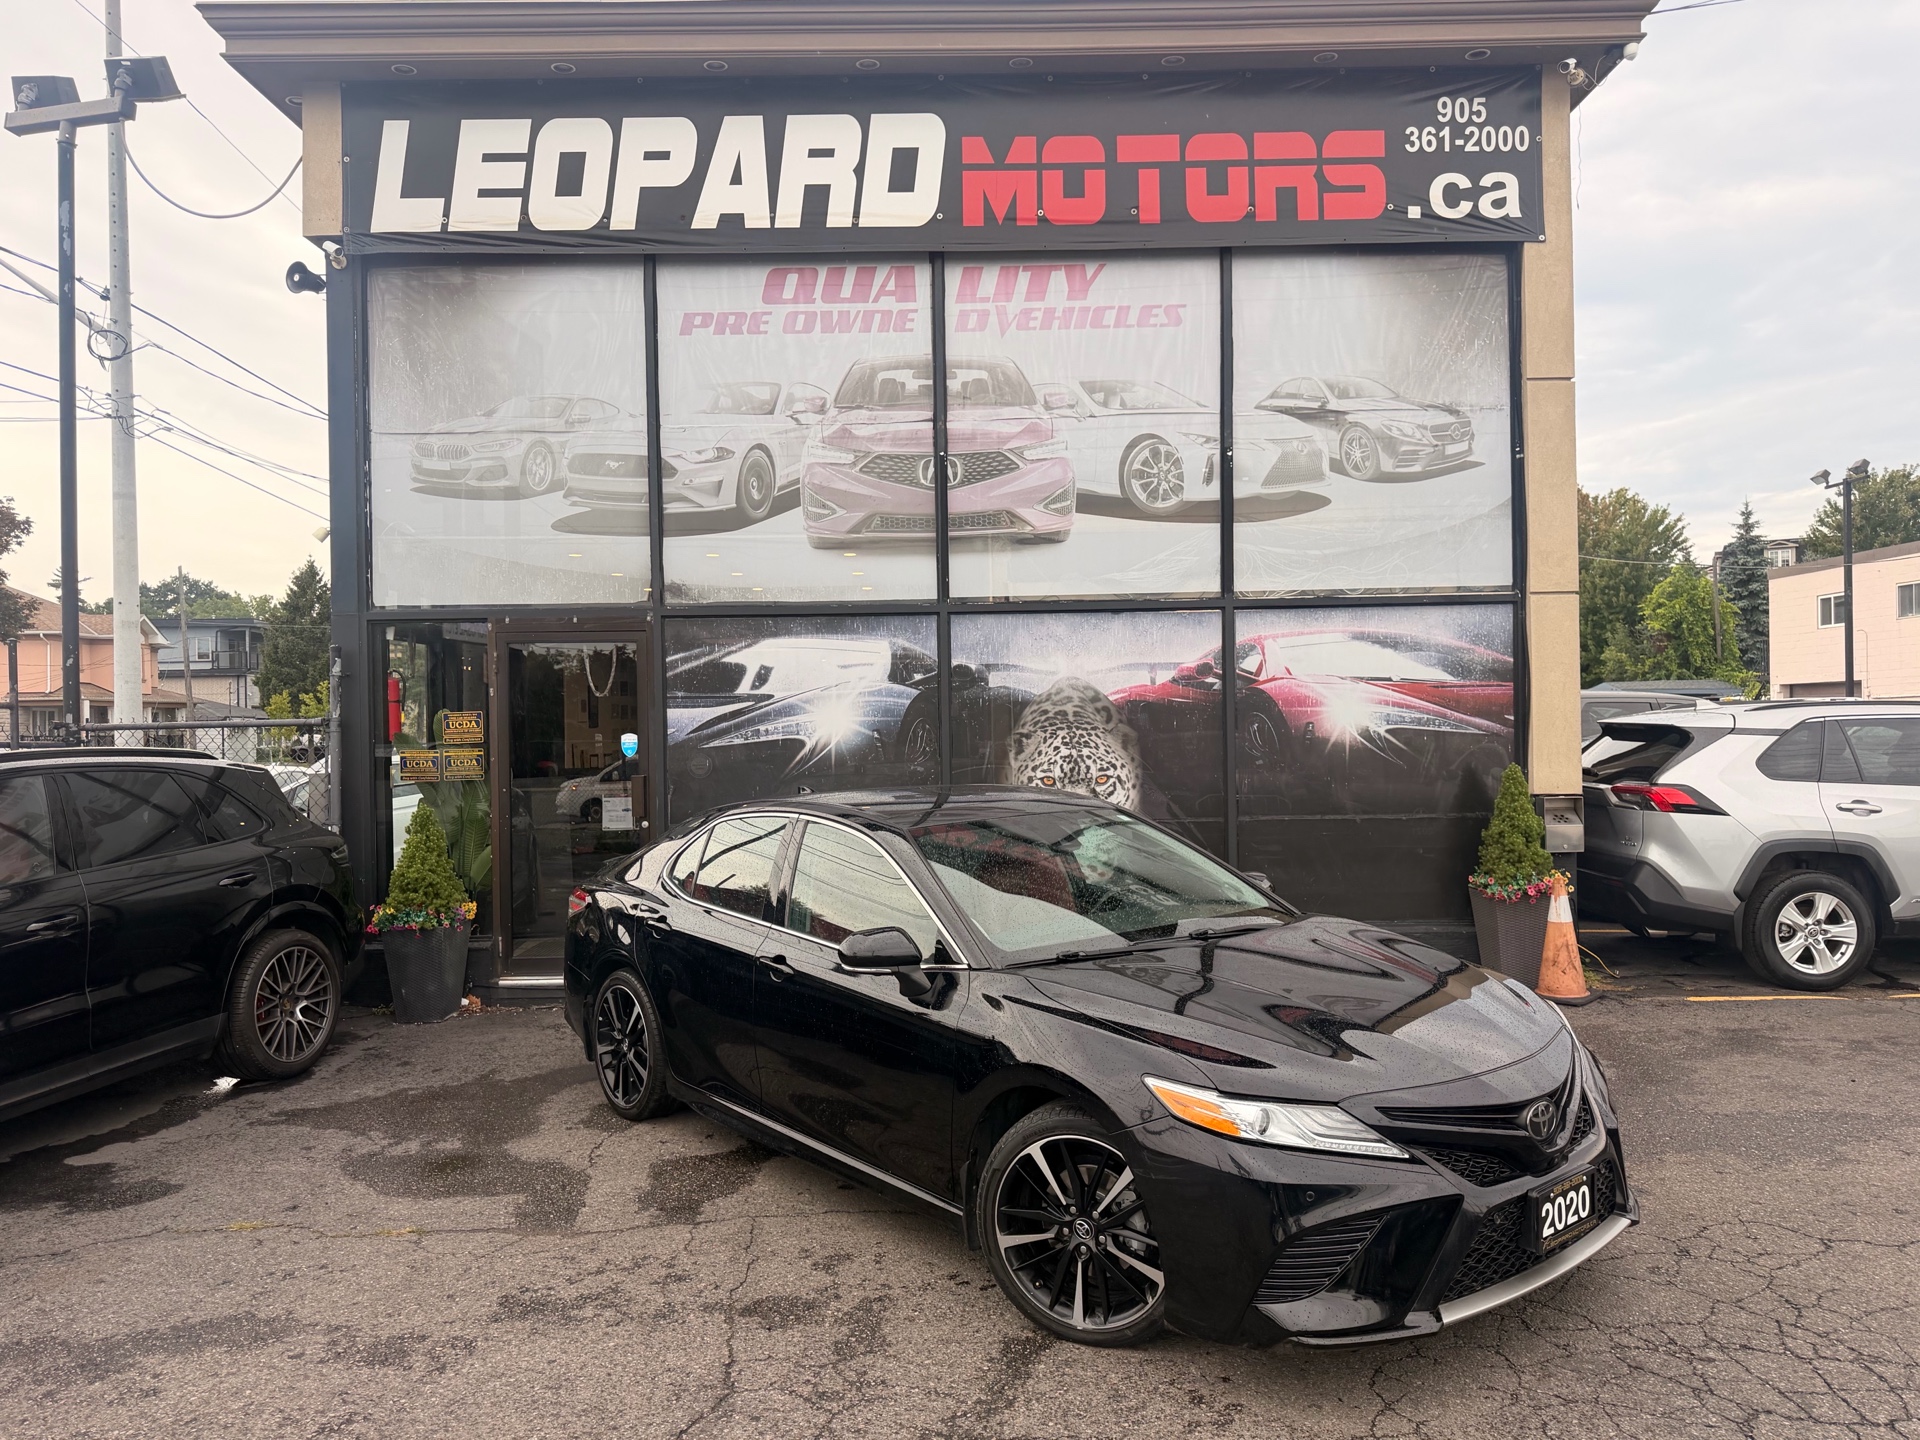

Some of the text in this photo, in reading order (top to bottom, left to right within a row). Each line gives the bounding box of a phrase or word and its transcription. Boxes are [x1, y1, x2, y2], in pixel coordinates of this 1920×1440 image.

[1436, 96, 1487, 123] 905
[1404, 125, 1530, 153] 361-2000
[370, 112, 1387, 233] LEOPARD MOTORS
[1407, 171, 1523, 219] .ca
[762, 263, 1107, 305] QUA LITY
[679, 311, 772, 336] PRE
[448, 720, 478, 729] UCDA
[406, 760, 434, 768] UCDA
[450, 759, 478, 767] UCDA
[1541, 1185, 1590, 1239] 2020
